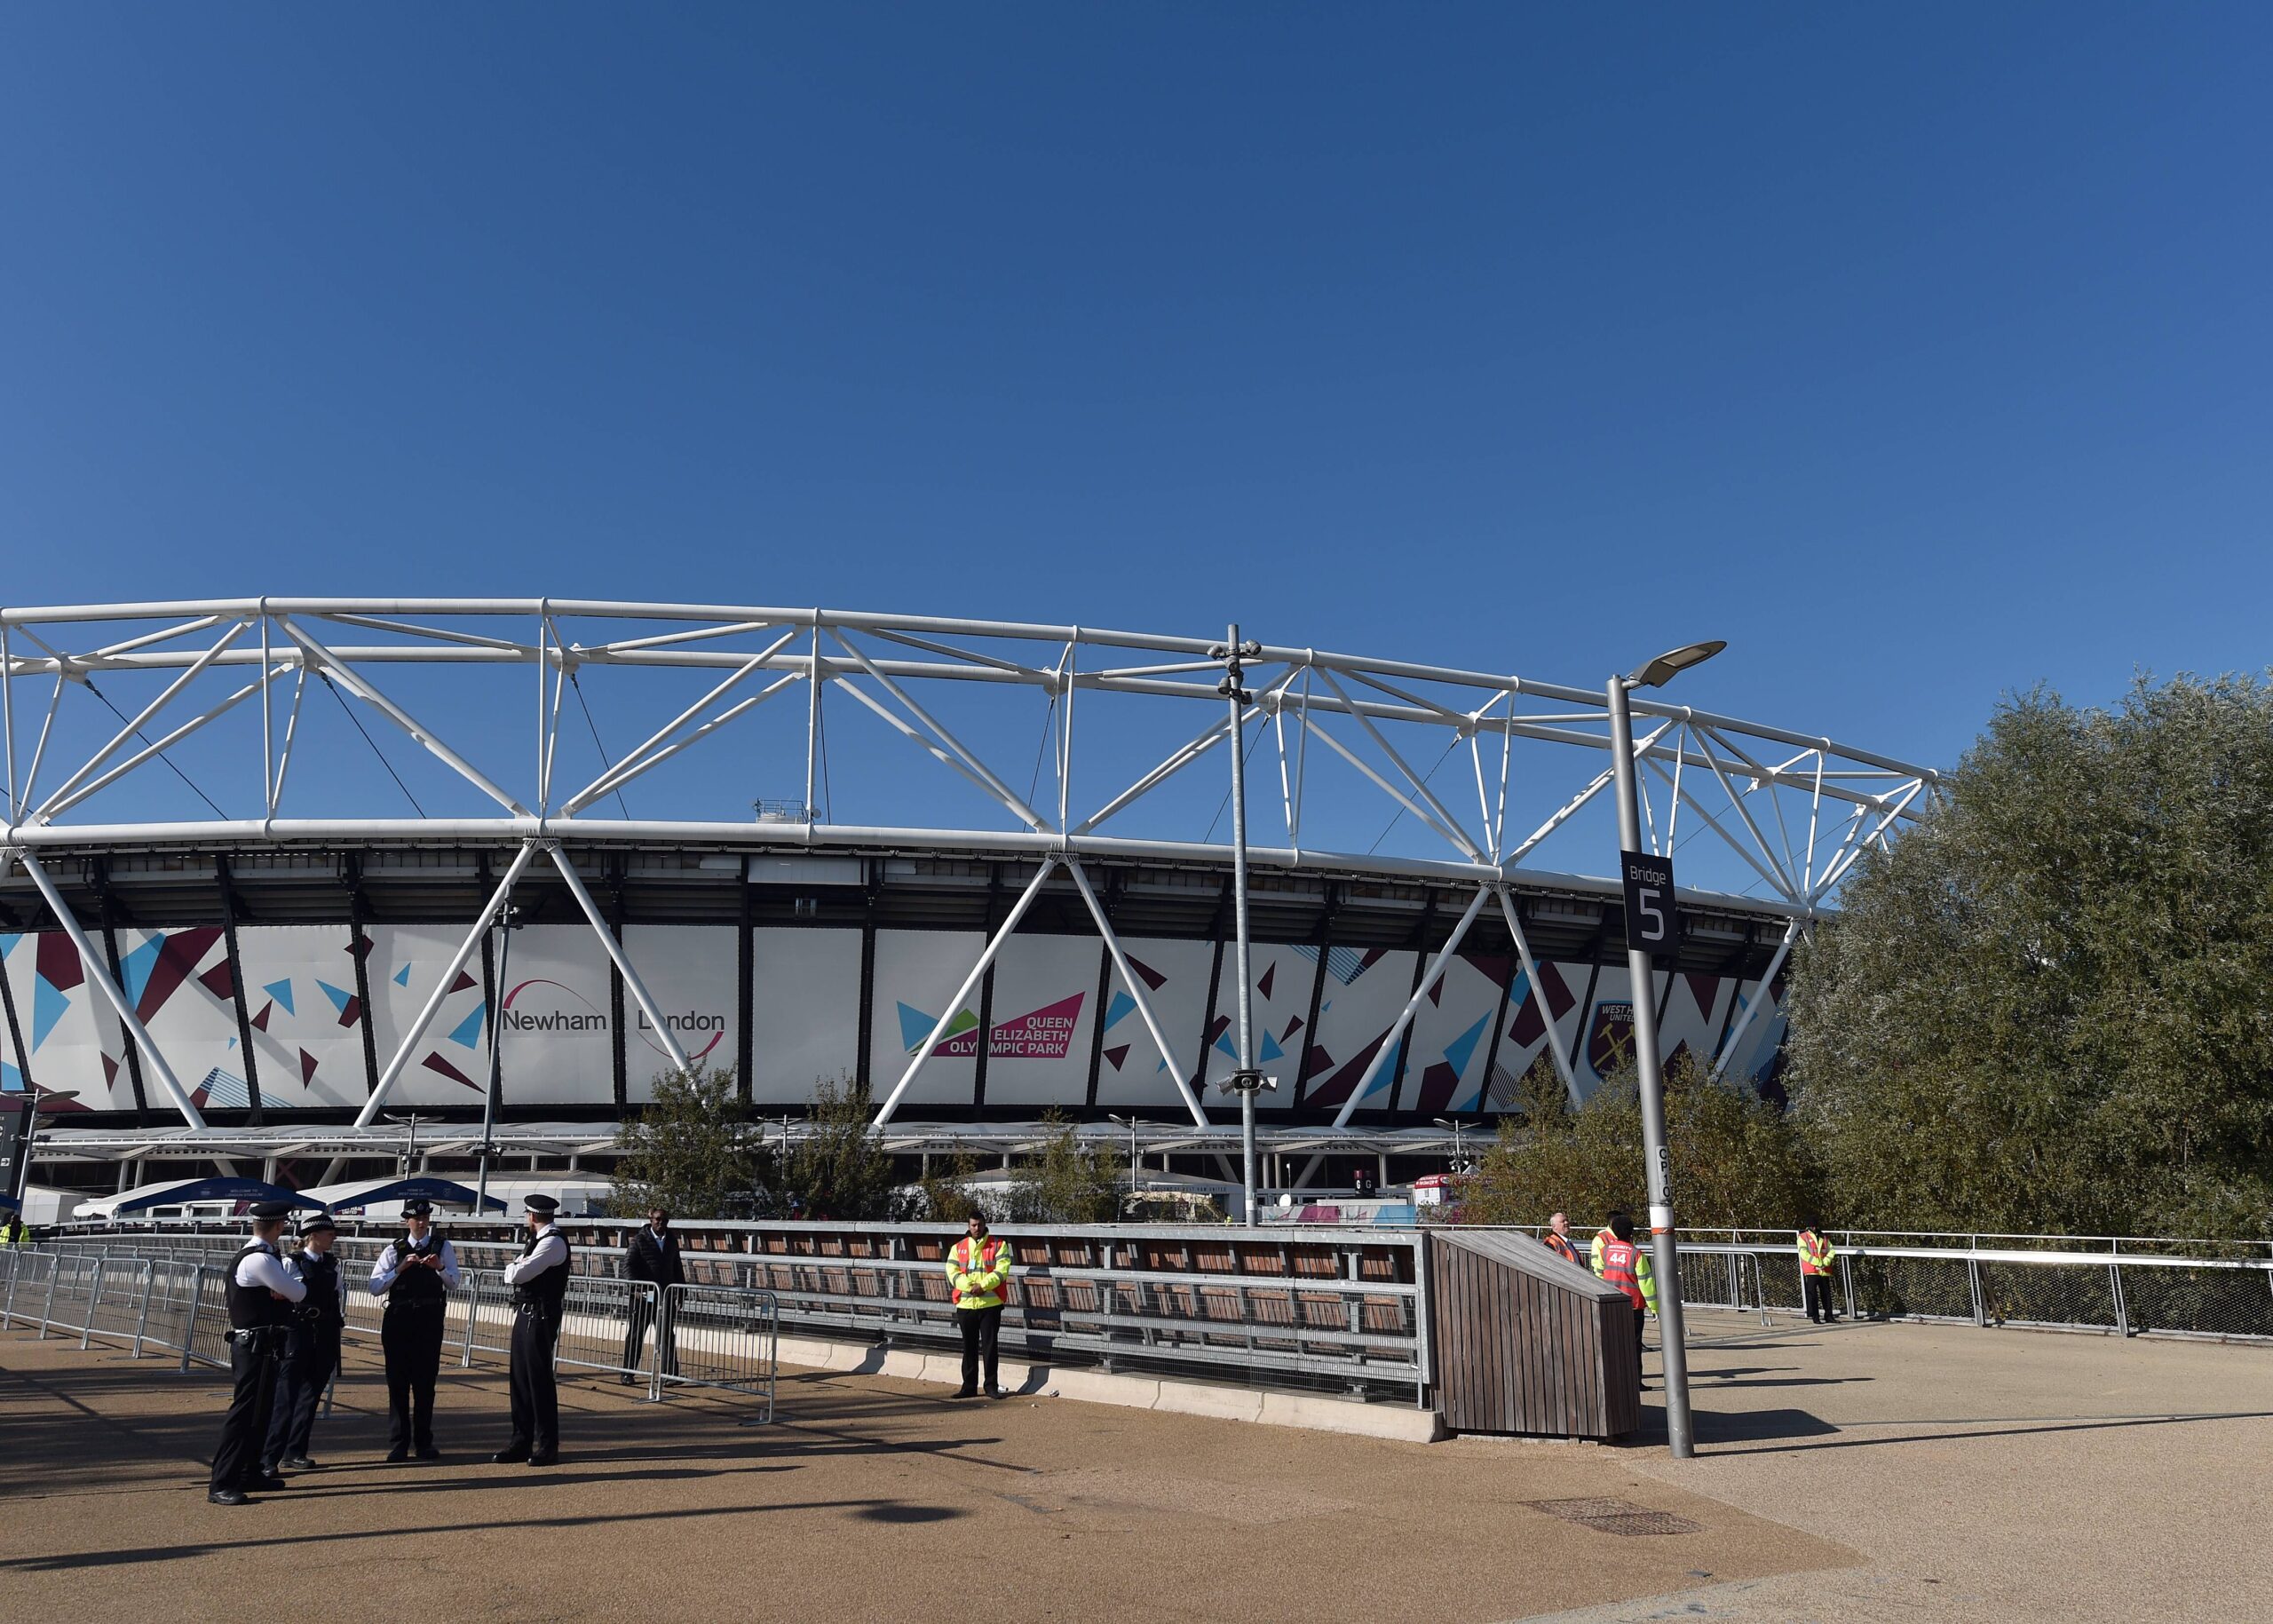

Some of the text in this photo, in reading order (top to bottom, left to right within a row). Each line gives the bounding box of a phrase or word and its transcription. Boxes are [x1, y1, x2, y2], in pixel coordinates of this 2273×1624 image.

[1629, 865, 1667, 886] Bridge
[1639, 888, 1665, 940] 5
[1602, 1004, 1627, 1014] WEST
[503, 1010, 606, 1031] Newham
[1026, 1017, 1073, 1029] QUEEN
[994, 1030, 1069, 1042] ELIZABETH
[1027, 1042, 1065, 1054] PARK
[1366, 1179, 1372, 1189] G
[1609, 1253, 1627, 1264] 44
